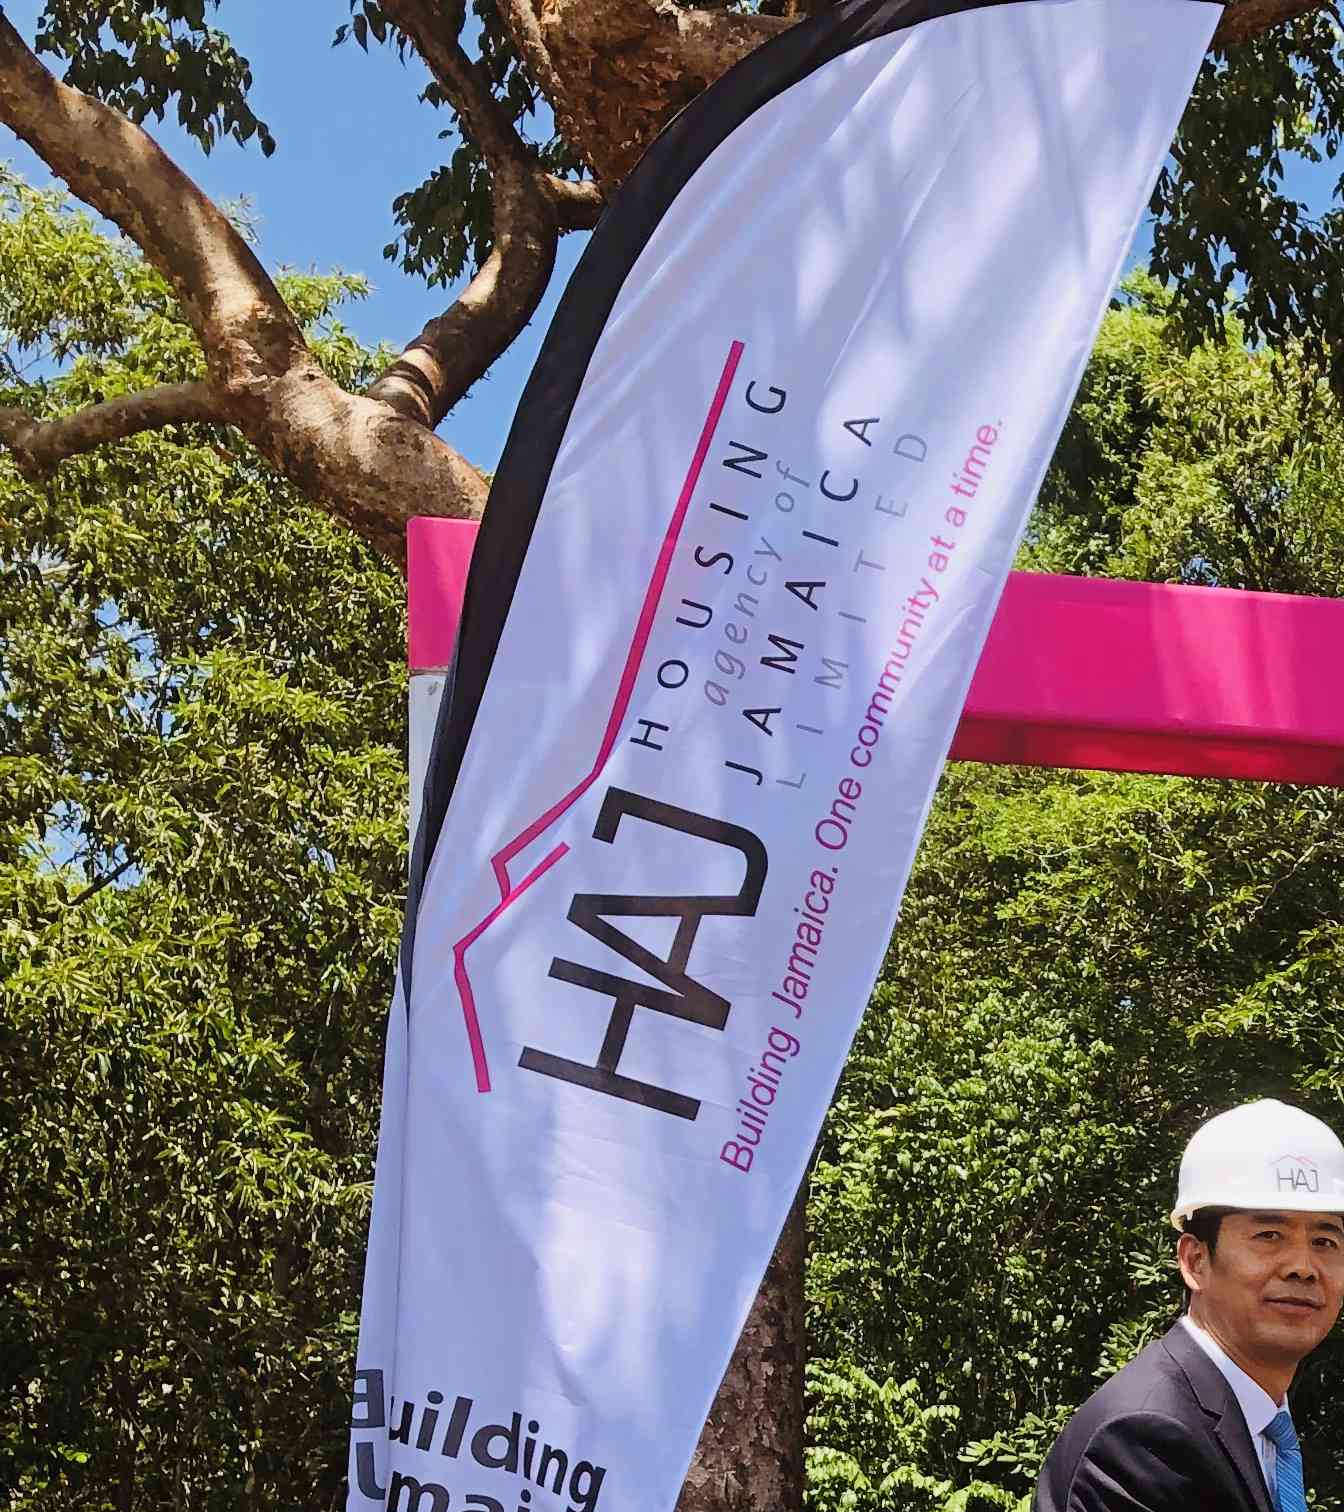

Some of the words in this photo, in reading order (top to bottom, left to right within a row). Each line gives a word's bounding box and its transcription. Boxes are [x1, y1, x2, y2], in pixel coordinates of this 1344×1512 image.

[944, 505, 968, 528] a
[948, 420, 1004, 499] time.
[631, 379, 787, 752] HOUSING
[703, 543, 784, 709] agency
[774, 463, 811, 514] of
[725, 415, 881, 786] JAMAICA
[775, 432, 929, 790] LIMITED
[927, 534, 957, 573] at
[850, 576, 941, 768] community
[815, 776, 863, 851] One
[518, 785, 769, 1121] HAJ
[771, 866, 840, 1019] Jamaica.
[720, 1025, 800, 1174] Building
[1276, 1167, 1320, 1193] HAJ
